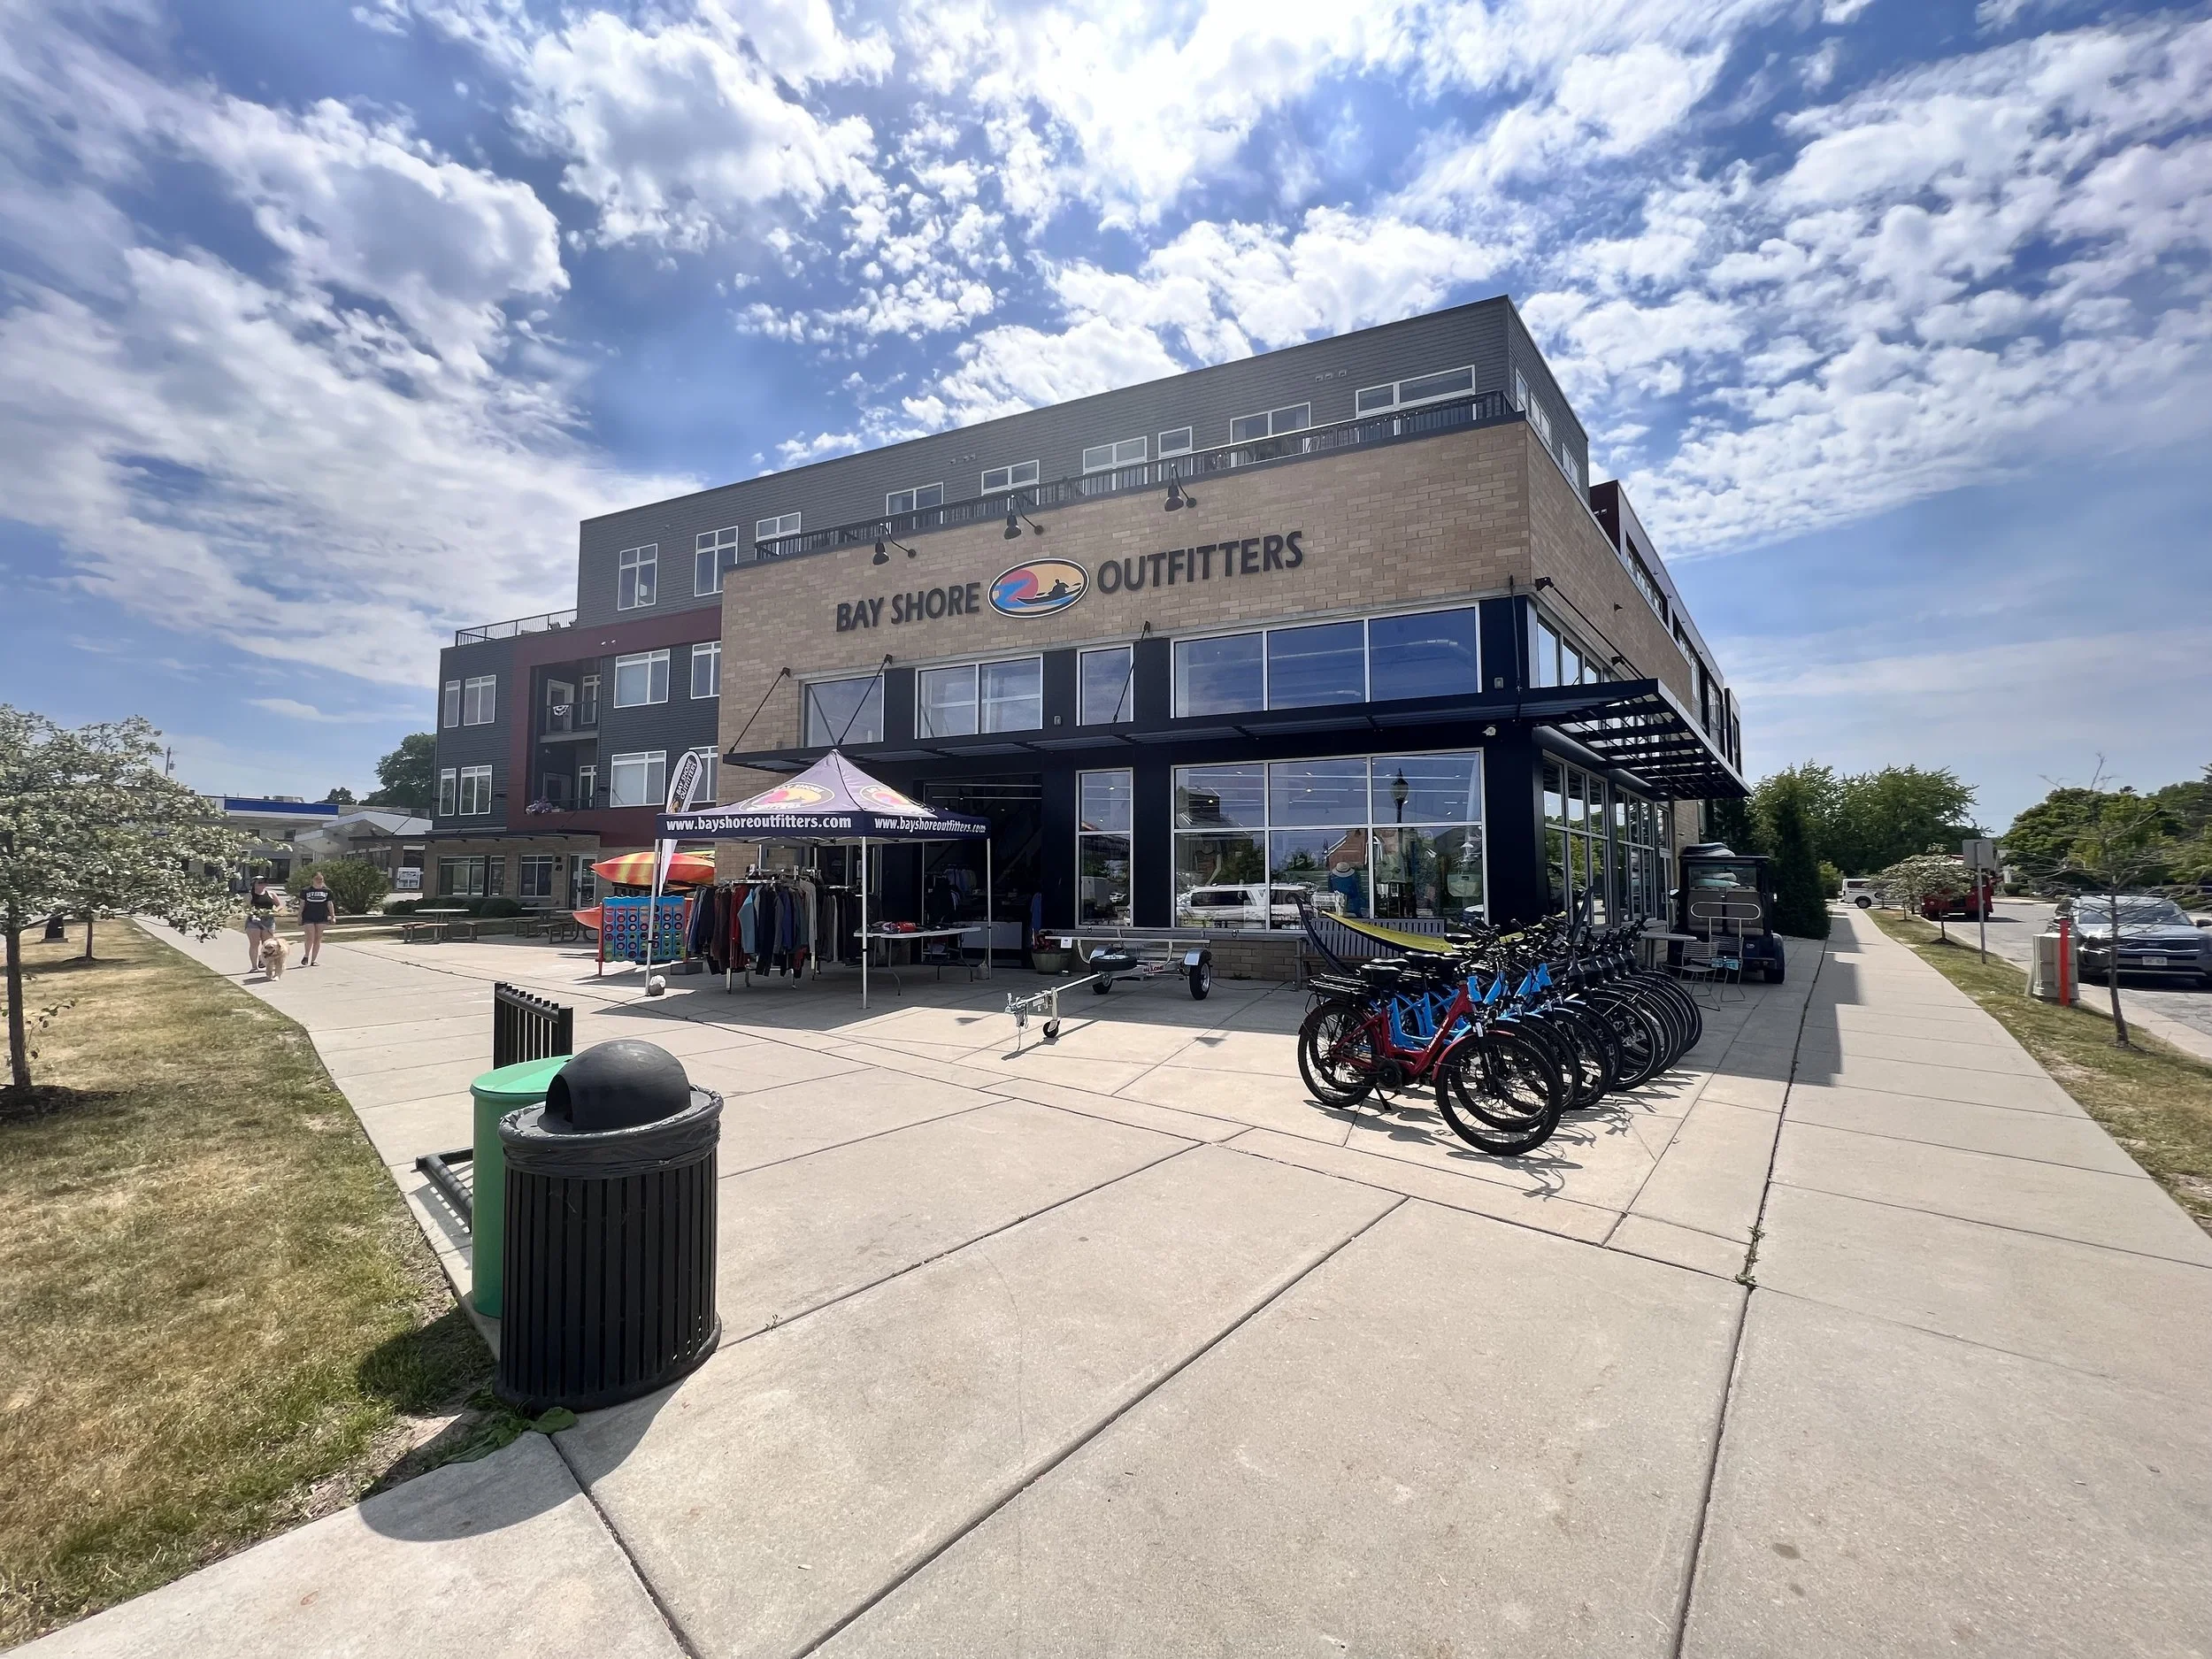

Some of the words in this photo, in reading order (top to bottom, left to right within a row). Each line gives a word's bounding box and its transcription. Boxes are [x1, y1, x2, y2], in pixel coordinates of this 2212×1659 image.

[836, 597, 884, 632] BAY
[891, 582, 980, 625] SHORE
[1097, 531, 1303, 594] OUTFITTERS
[680, 758, 693, 782] SHORE
[680, 763, 697, 800] OUTFITTERS
[666, 814, 852, 833] www.bayshoreoutfitters.com
[874, 816, 986, 833] www.bayshoreoutfitters.com
